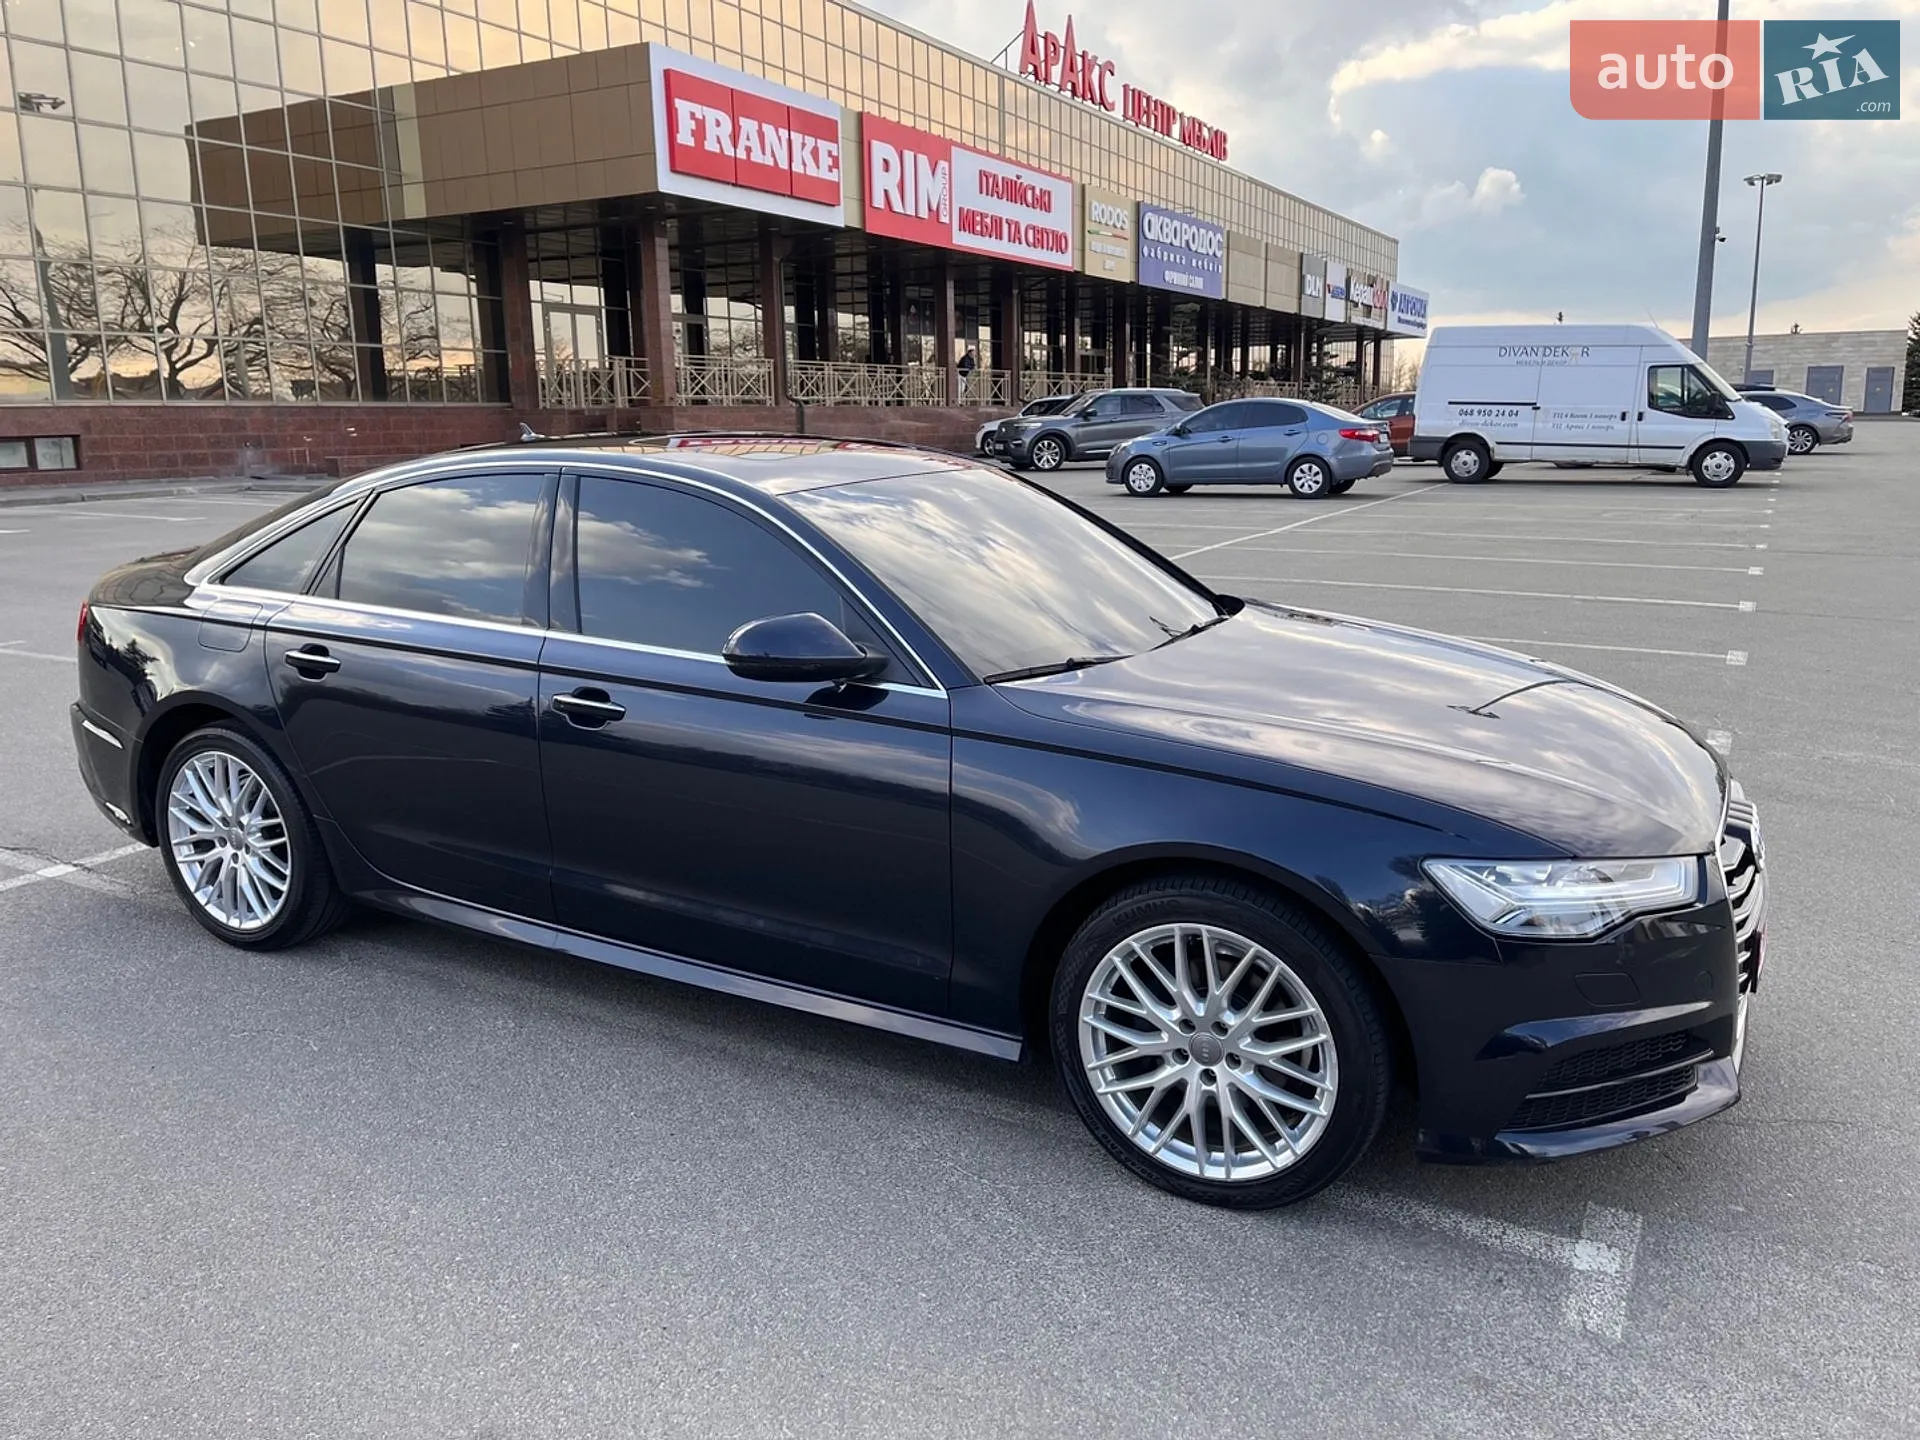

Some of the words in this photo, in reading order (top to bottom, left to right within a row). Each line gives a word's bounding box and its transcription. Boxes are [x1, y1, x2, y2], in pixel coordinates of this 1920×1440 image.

[1019, 0, 1115, 111] АРАКС
[674, 98, 839, 182] FRANKE
[870, 140, 949, 224] RIM
[979, 169, 1052, 213] ІТАЛІЙСЬКІ
[959, 207, 1003, 241] МЕБЛІ
[1006, 220, 1022, 245] ТА
[1024, 224, 1068, 255] СВІТЛО
[1090, 200, 1128, 230] RODOS
[1498, 346, 1539, 358] DIVAN
[1542, 346, 1590, 359] DEKR
[1458, 408, 1474, 416] 068
[1476, 408, 1493, 417] 950
[1495, 409, 1506, 417] 24
[1508, 409, 1519, 417] 04
